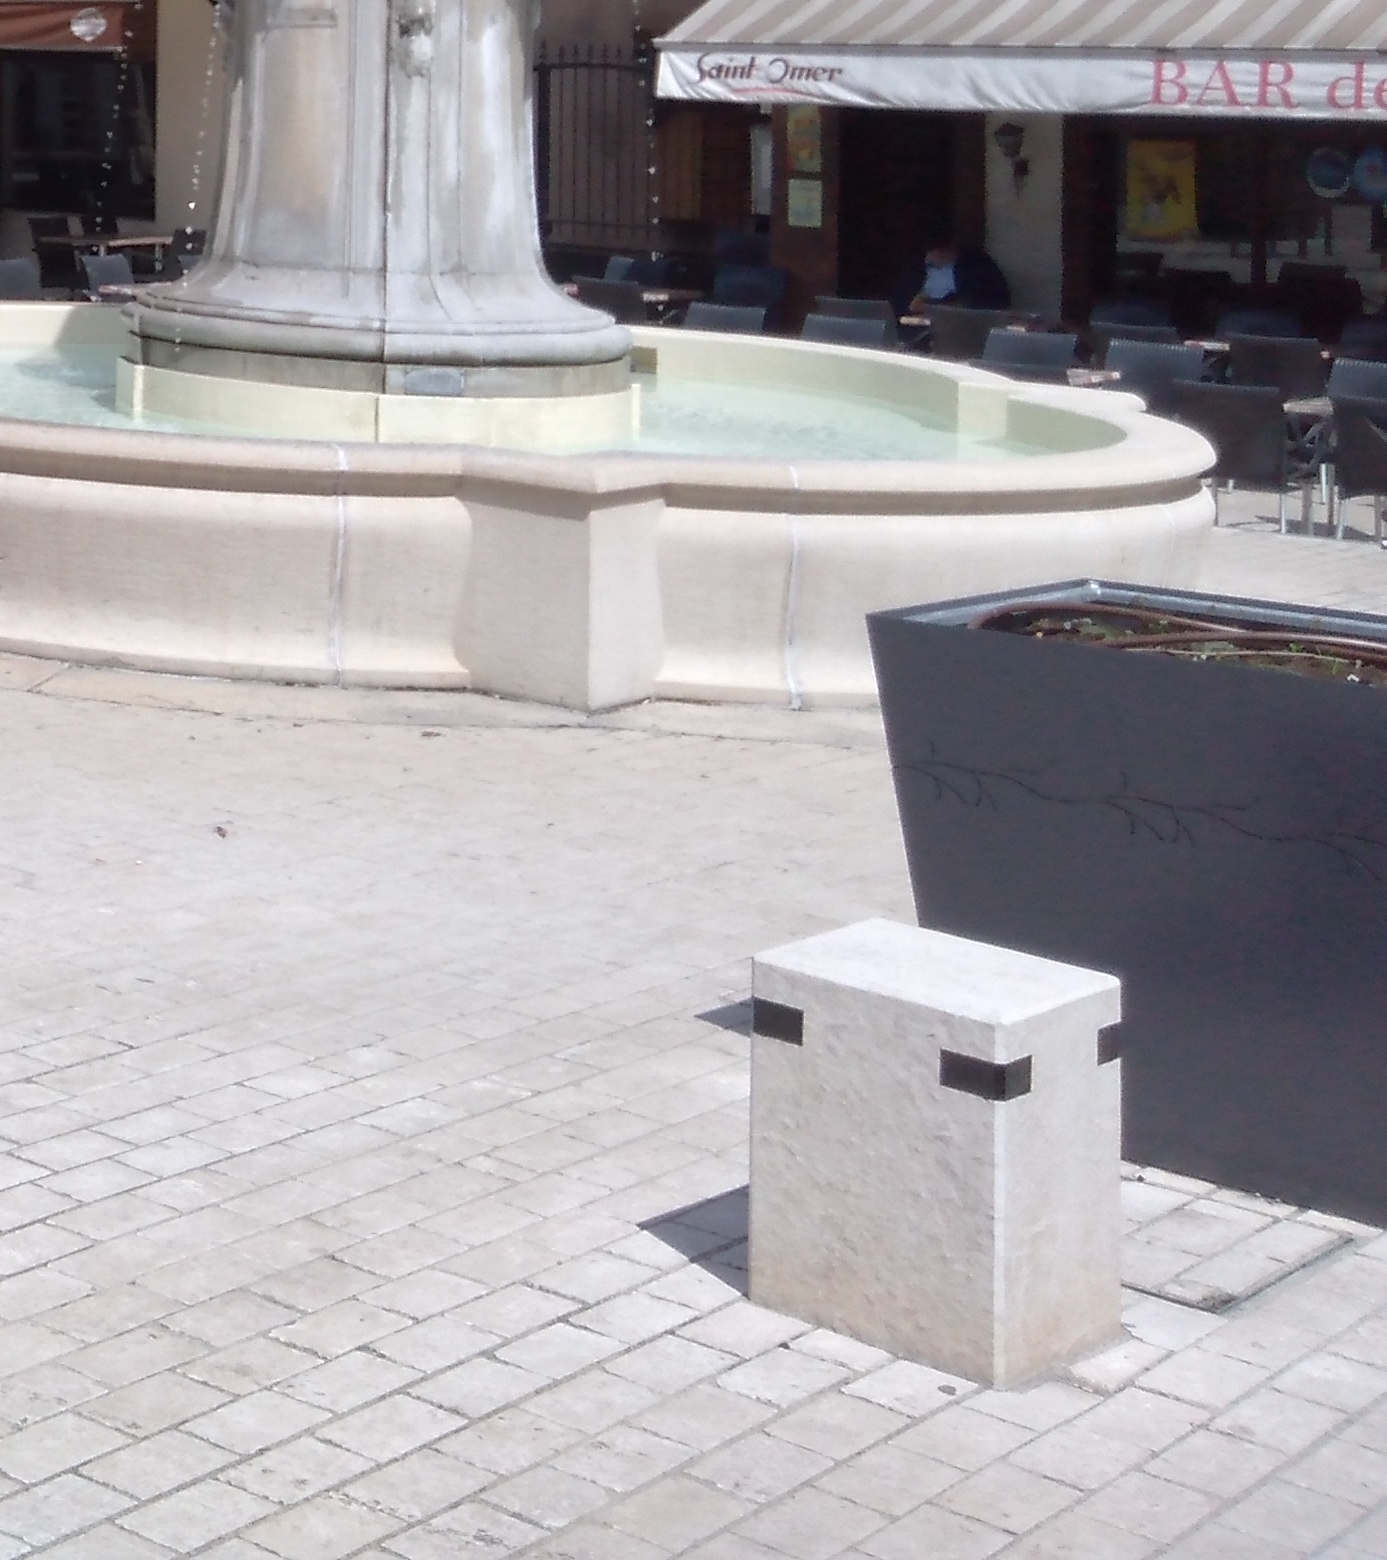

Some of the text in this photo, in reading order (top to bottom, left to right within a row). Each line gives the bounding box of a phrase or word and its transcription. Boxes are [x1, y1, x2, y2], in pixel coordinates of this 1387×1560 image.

[695, 52, 844, 85] Saint Omer
[1147, 59, 1301, 109] BAR
